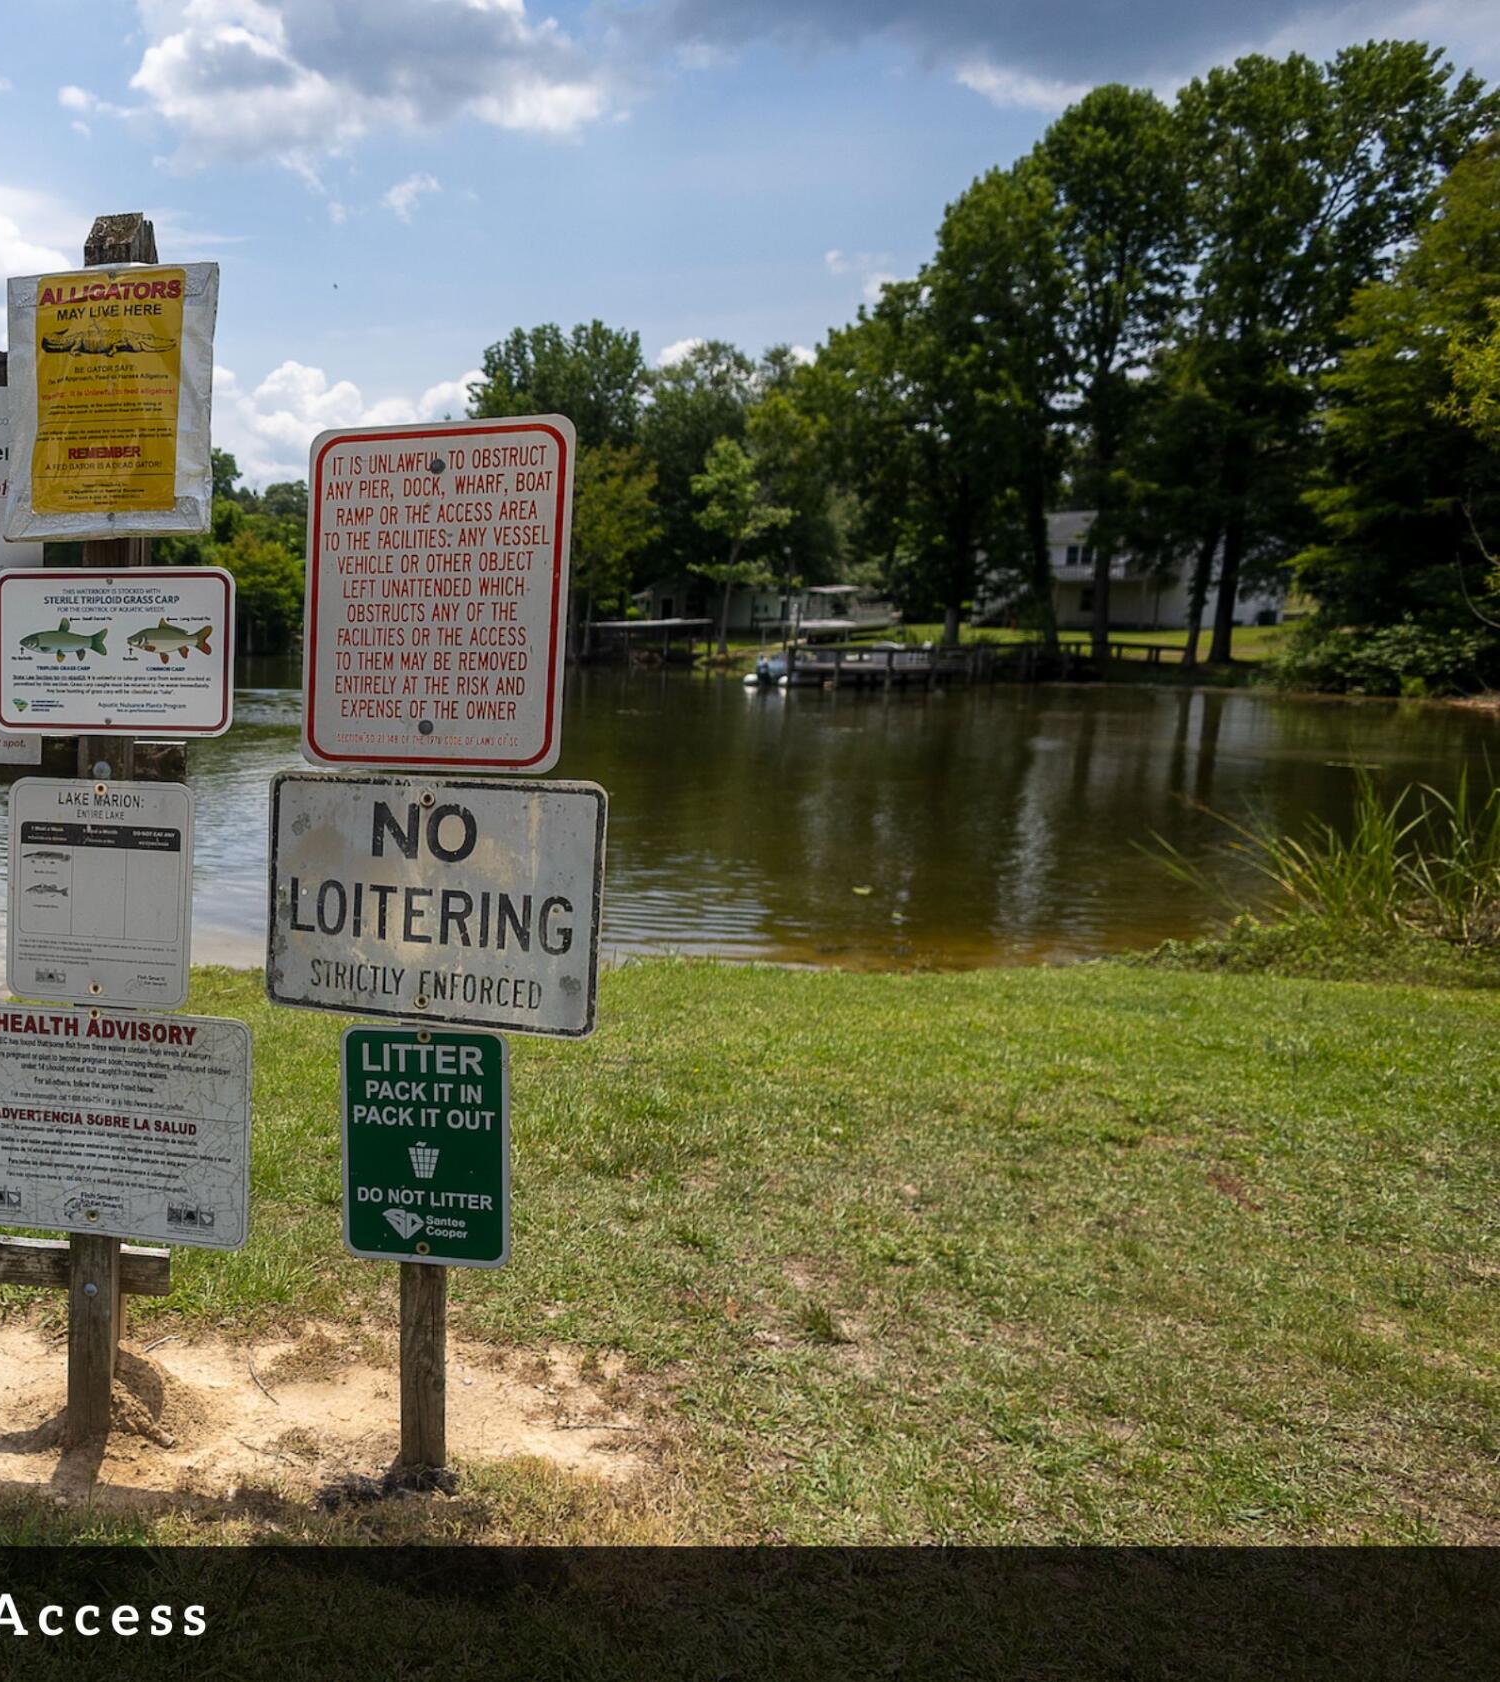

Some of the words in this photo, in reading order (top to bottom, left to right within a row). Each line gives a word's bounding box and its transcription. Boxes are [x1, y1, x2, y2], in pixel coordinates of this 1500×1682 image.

[39, 280, 182, 306] ALLIGATORS
[57, 308, 85, 320] MAY
[90, 305, 119, 318] LIVE
[124, 304, 162, 316] HERE
[68, 446, 141, 460] REMEMBER
[333, 457, 344, 476] IT
[350, 456, 362, 475] IS
[448, 450, 464, 470] TO
[472, 445, 547, 469] OBSTRUCT
[326, 481, 353, 500] ANY
[360, 480, 394, 501] PIER,
[404, 476, 444, 499] DOCK,
[455, 474, 508, 496] WHARF,
[516, 471, 552, 492] BOAT
[337, 507, 373, 526] RAMP
[380, 506, 398, 525] OR
[405, 502, 431, 524] THE
[437, 502, 492, 523] ACCESS
[499, 500, 537, 520] AREA
[324, 532, 340, 552] TO
[346, 532, 370, 550] THE
[458, 528, 487, 547] ANY
[494, 525, 550, 546] VESSEL
[338, 555, 394, 574] VEHICLE
[401, 554, 419, 573] OR
[426, 553, 471, 573] OTHER
[479, 551, 534, 572] OBJECT
[343, 580, 376, 598] LEFT
[382, 578, 471, 598] UNATTENDED
[479, 576, 524, 596] WHICH
[44, 596, 78, 604] STERILE
[81, 596, 122, 604] TRIPLOID
[124, 596, 153, 604] GRASS
[155, 596, 179, 604] CARP
[348, 603, 425, 623] OBSTRUCTS
[432, 603, 460, 622] ANY
[467, 602, 484, 622] OF
[492, 602, 518, 621] THE
[342, 700, 402, 718] EXPENSE
[410, 700, 428, 718] OF
[433, 700, 459, 720] THE
[466, 701, 516, 720] OWNER
[4, 740, 26, 749] spot.
[58, 792, 89, 806] LAKE
[94, 793, 144, 808] MARION:
[106, 812, 124, 820] LAKE
[372, 800, 477, 862] NO
[290, 876, 573, 955] LOITERING
[311, 958, 404, 996] STRICTLY
[418, 970, 541, 1009] ENFORCED
[86, 1019, 197, 1045] ADVISORY
[362, 1043, 484, 1075] LITTER
[366, 1080, 426, 1101] PACK
[434, 1084, 453, 1102] IT
[461, 1085, 481, 1104] IN
[87, 1114, 130, 1128] SOBRE
[134, 1118, 150, 1131] LA
[154, 1120, 196, 1135] SALUD
[354, 1105, 414, 1126] PACK
[421, 1108, 440, 1127] IT
[447, 1110, 495, 1130] OUT
[358, 1187, 382, 1202] DO
[388, 1189, 425, 1205] NOT
[430, 1192, 492, 1210] LITTER
[426, 1215, 465, 1228] Santee
[426, 1226, 468, 1238] Cooper
